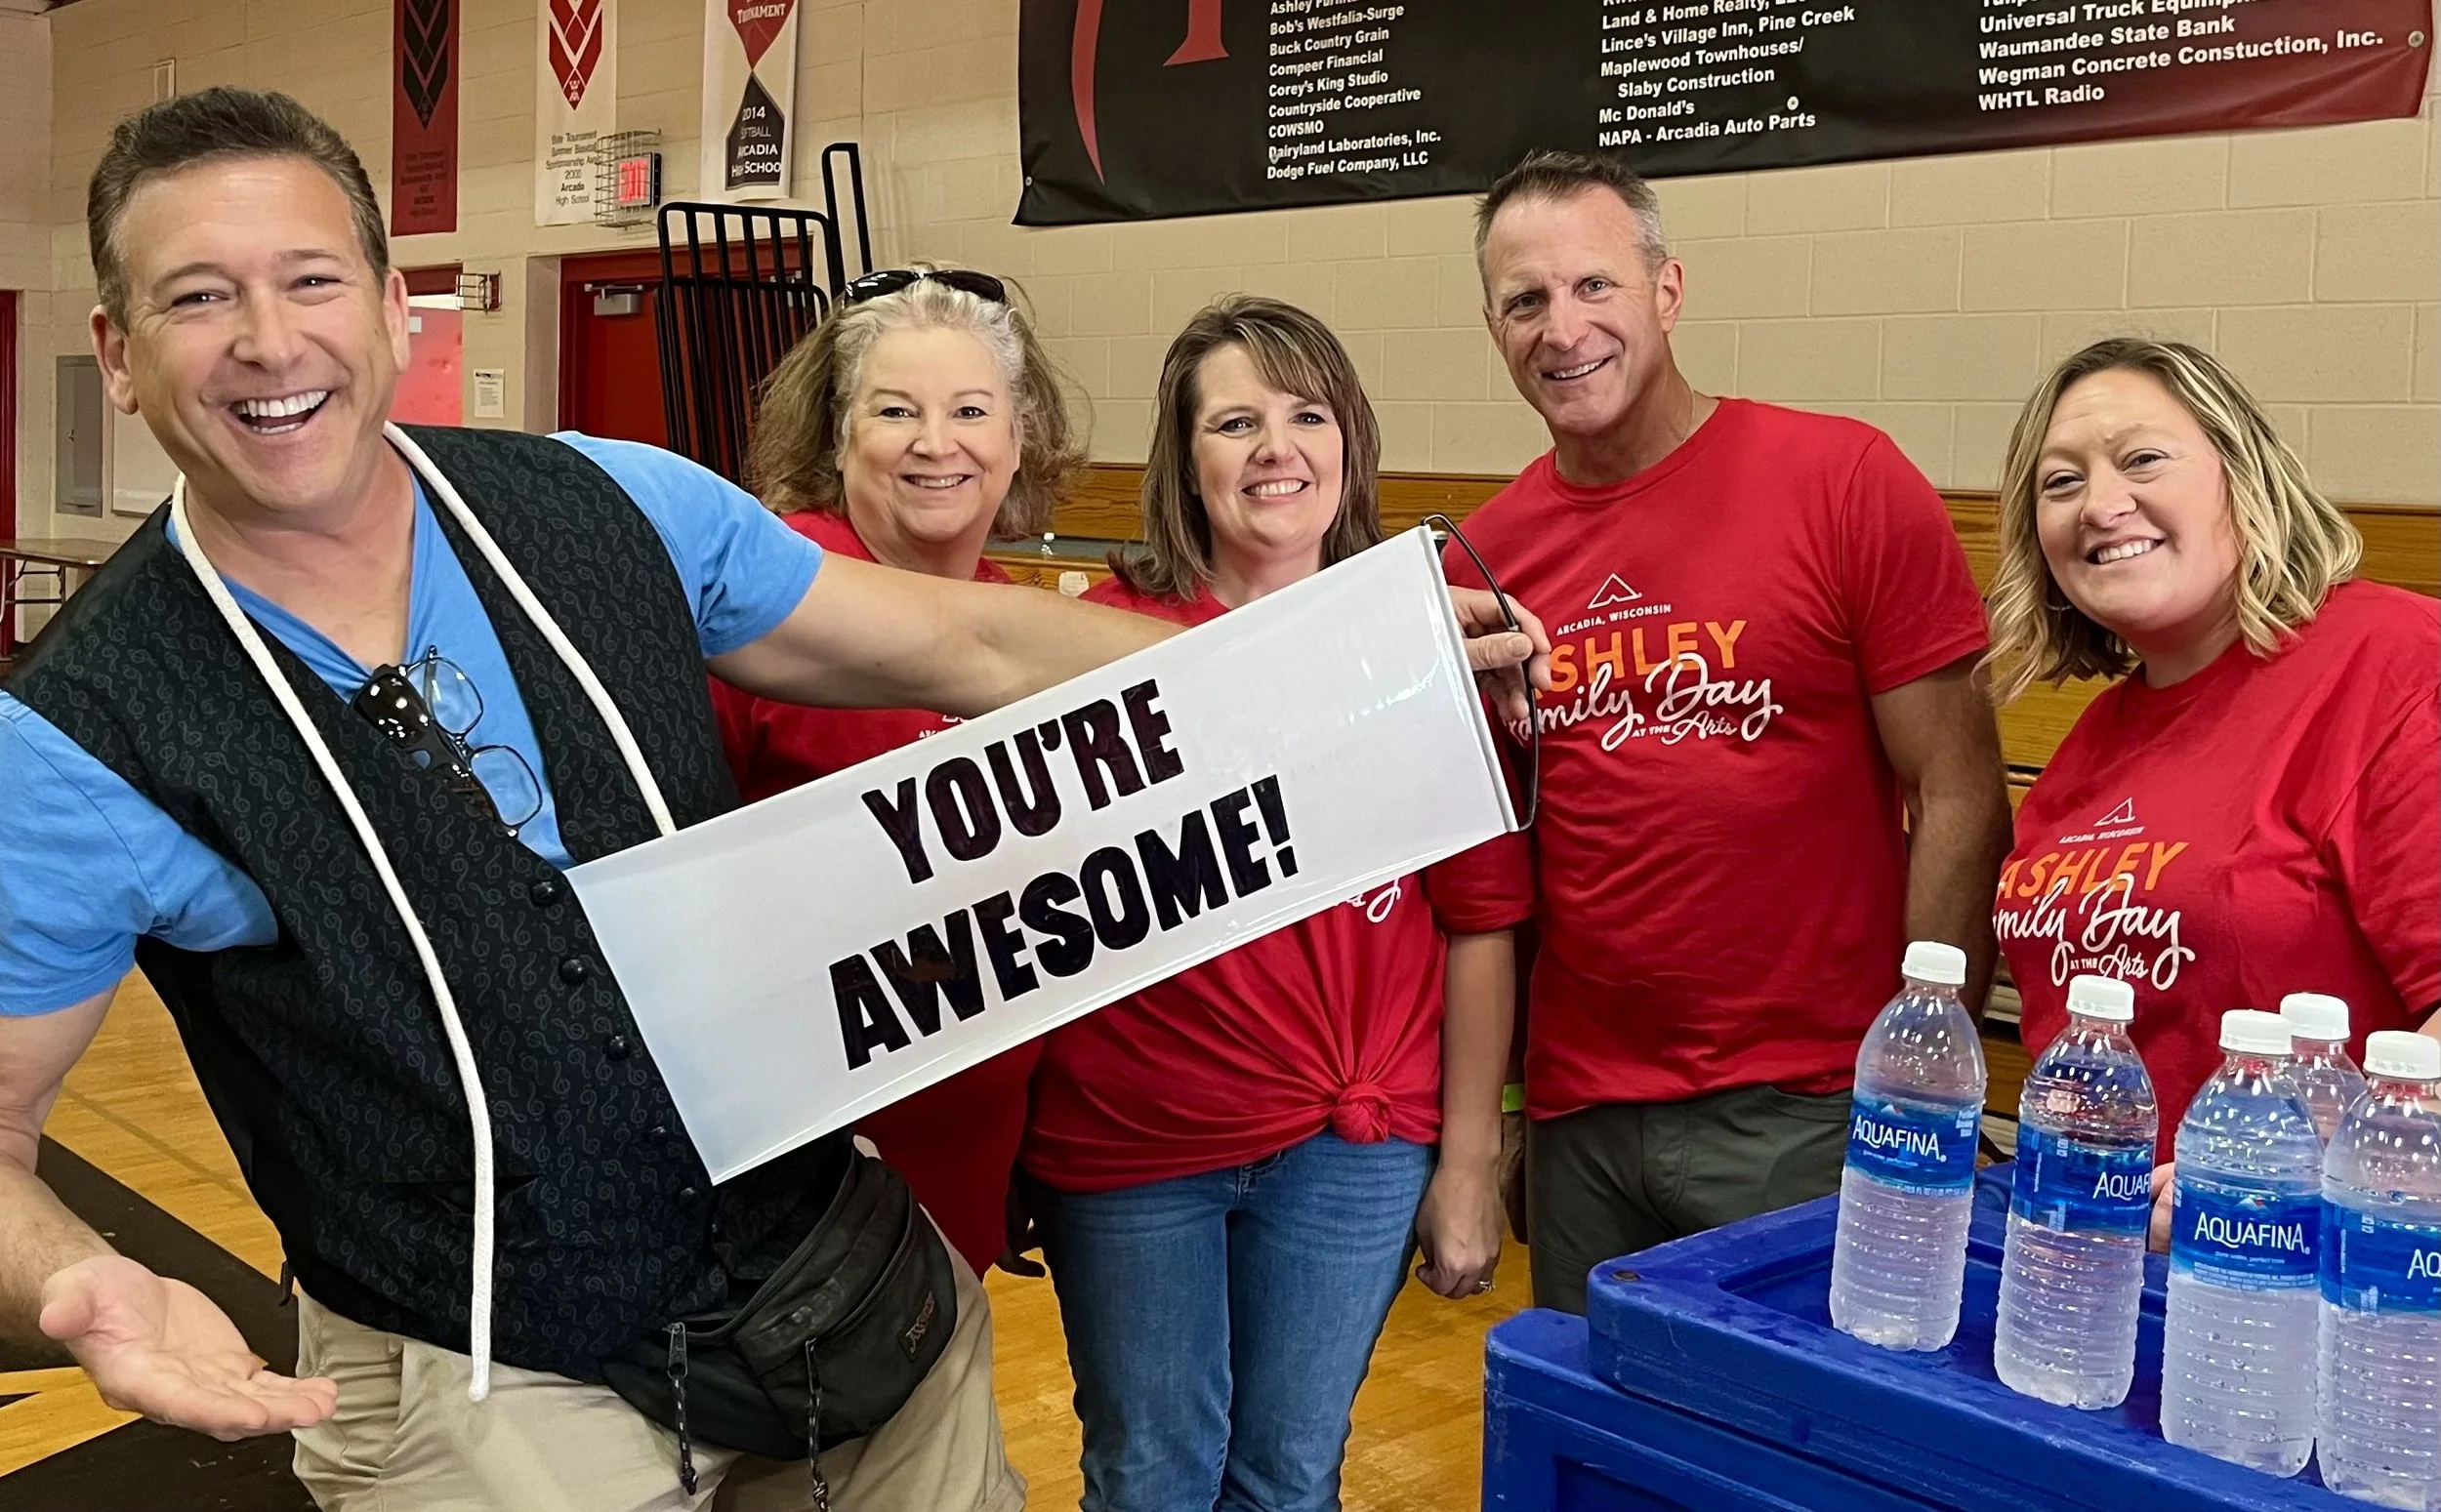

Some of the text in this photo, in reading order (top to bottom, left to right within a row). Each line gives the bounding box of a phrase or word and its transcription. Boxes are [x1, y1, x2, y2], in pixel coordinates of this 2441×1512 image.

[1269, 6, 1404, 36] Bob's Westfalia-Surge
[1270, 0, 1312, 15] Ashley
[1602, 0, 1769, 29] Land & Home Realty,
[1980, 6, 2076, 33] Universal
[2082, 0, 2144, 20] Truck
[1269, 26, 1389, 56] Buck Country Grain
[1601, 5, 1855, 54] Lince's Village Inn, Pine Creek
[1979, 15, 2236, 60] Waumandee State Bank
[1269, 48, 1384, 77] Compeer Financial
[1600, 36, 1804, 77] Maplewood Townhouses/
[1978, 30, 2383, 86] Wegman Concrete Constuction, Inc.
[1269, 70, 1388, 98] Corey's King Studio
[1618, 67, 1775, 98] Slaby Construction
[1978, 84, 2105, 111] WHTL Radio
[1269, 88, 1422, 117] Countryside Cooperative
[1598, 100, 1695, 124] Mc Donald's
[1268, 120, 1324, 139] COWSMO
[1269, 130, 1441, 160] Dairyland Laboratories, Inc.
[1598, 129, 1642, 146] NAPA
[1655, 122, 1719, 142] Arcadia
[1723, 118, 1763, 135] Auto
[1768, 112, 1816, 131] Parts
[744, 160, 782, 174] SCHOO
[1267, 150, 1428, 181] Dodge Fuel Company, LLC
[1556, 603, 1672, 636] ARCADIA, WISCONSIN
[1536, 620, 1747, 700] SHLEY
[1509, 653, 1784, 752] amily Day
[1631, 711, 1737, 746] AT THE Arts
[861, 678, 1184, 884] YOU'RE
[1999, 841, 2189, 899] ASHLEY
[828, 774, 1300, 1071] AWESOME!
[1993, 873, 2196, 991] mily Day
[2070, 944, 2149, 981] AT THE Arts
[1852, 1115, 1940, 1161] AQUAFINA
[2092, 1171, 2150, 1201] AQUAF
[2194, 1211, 2305, 1253] AQUAFINA
